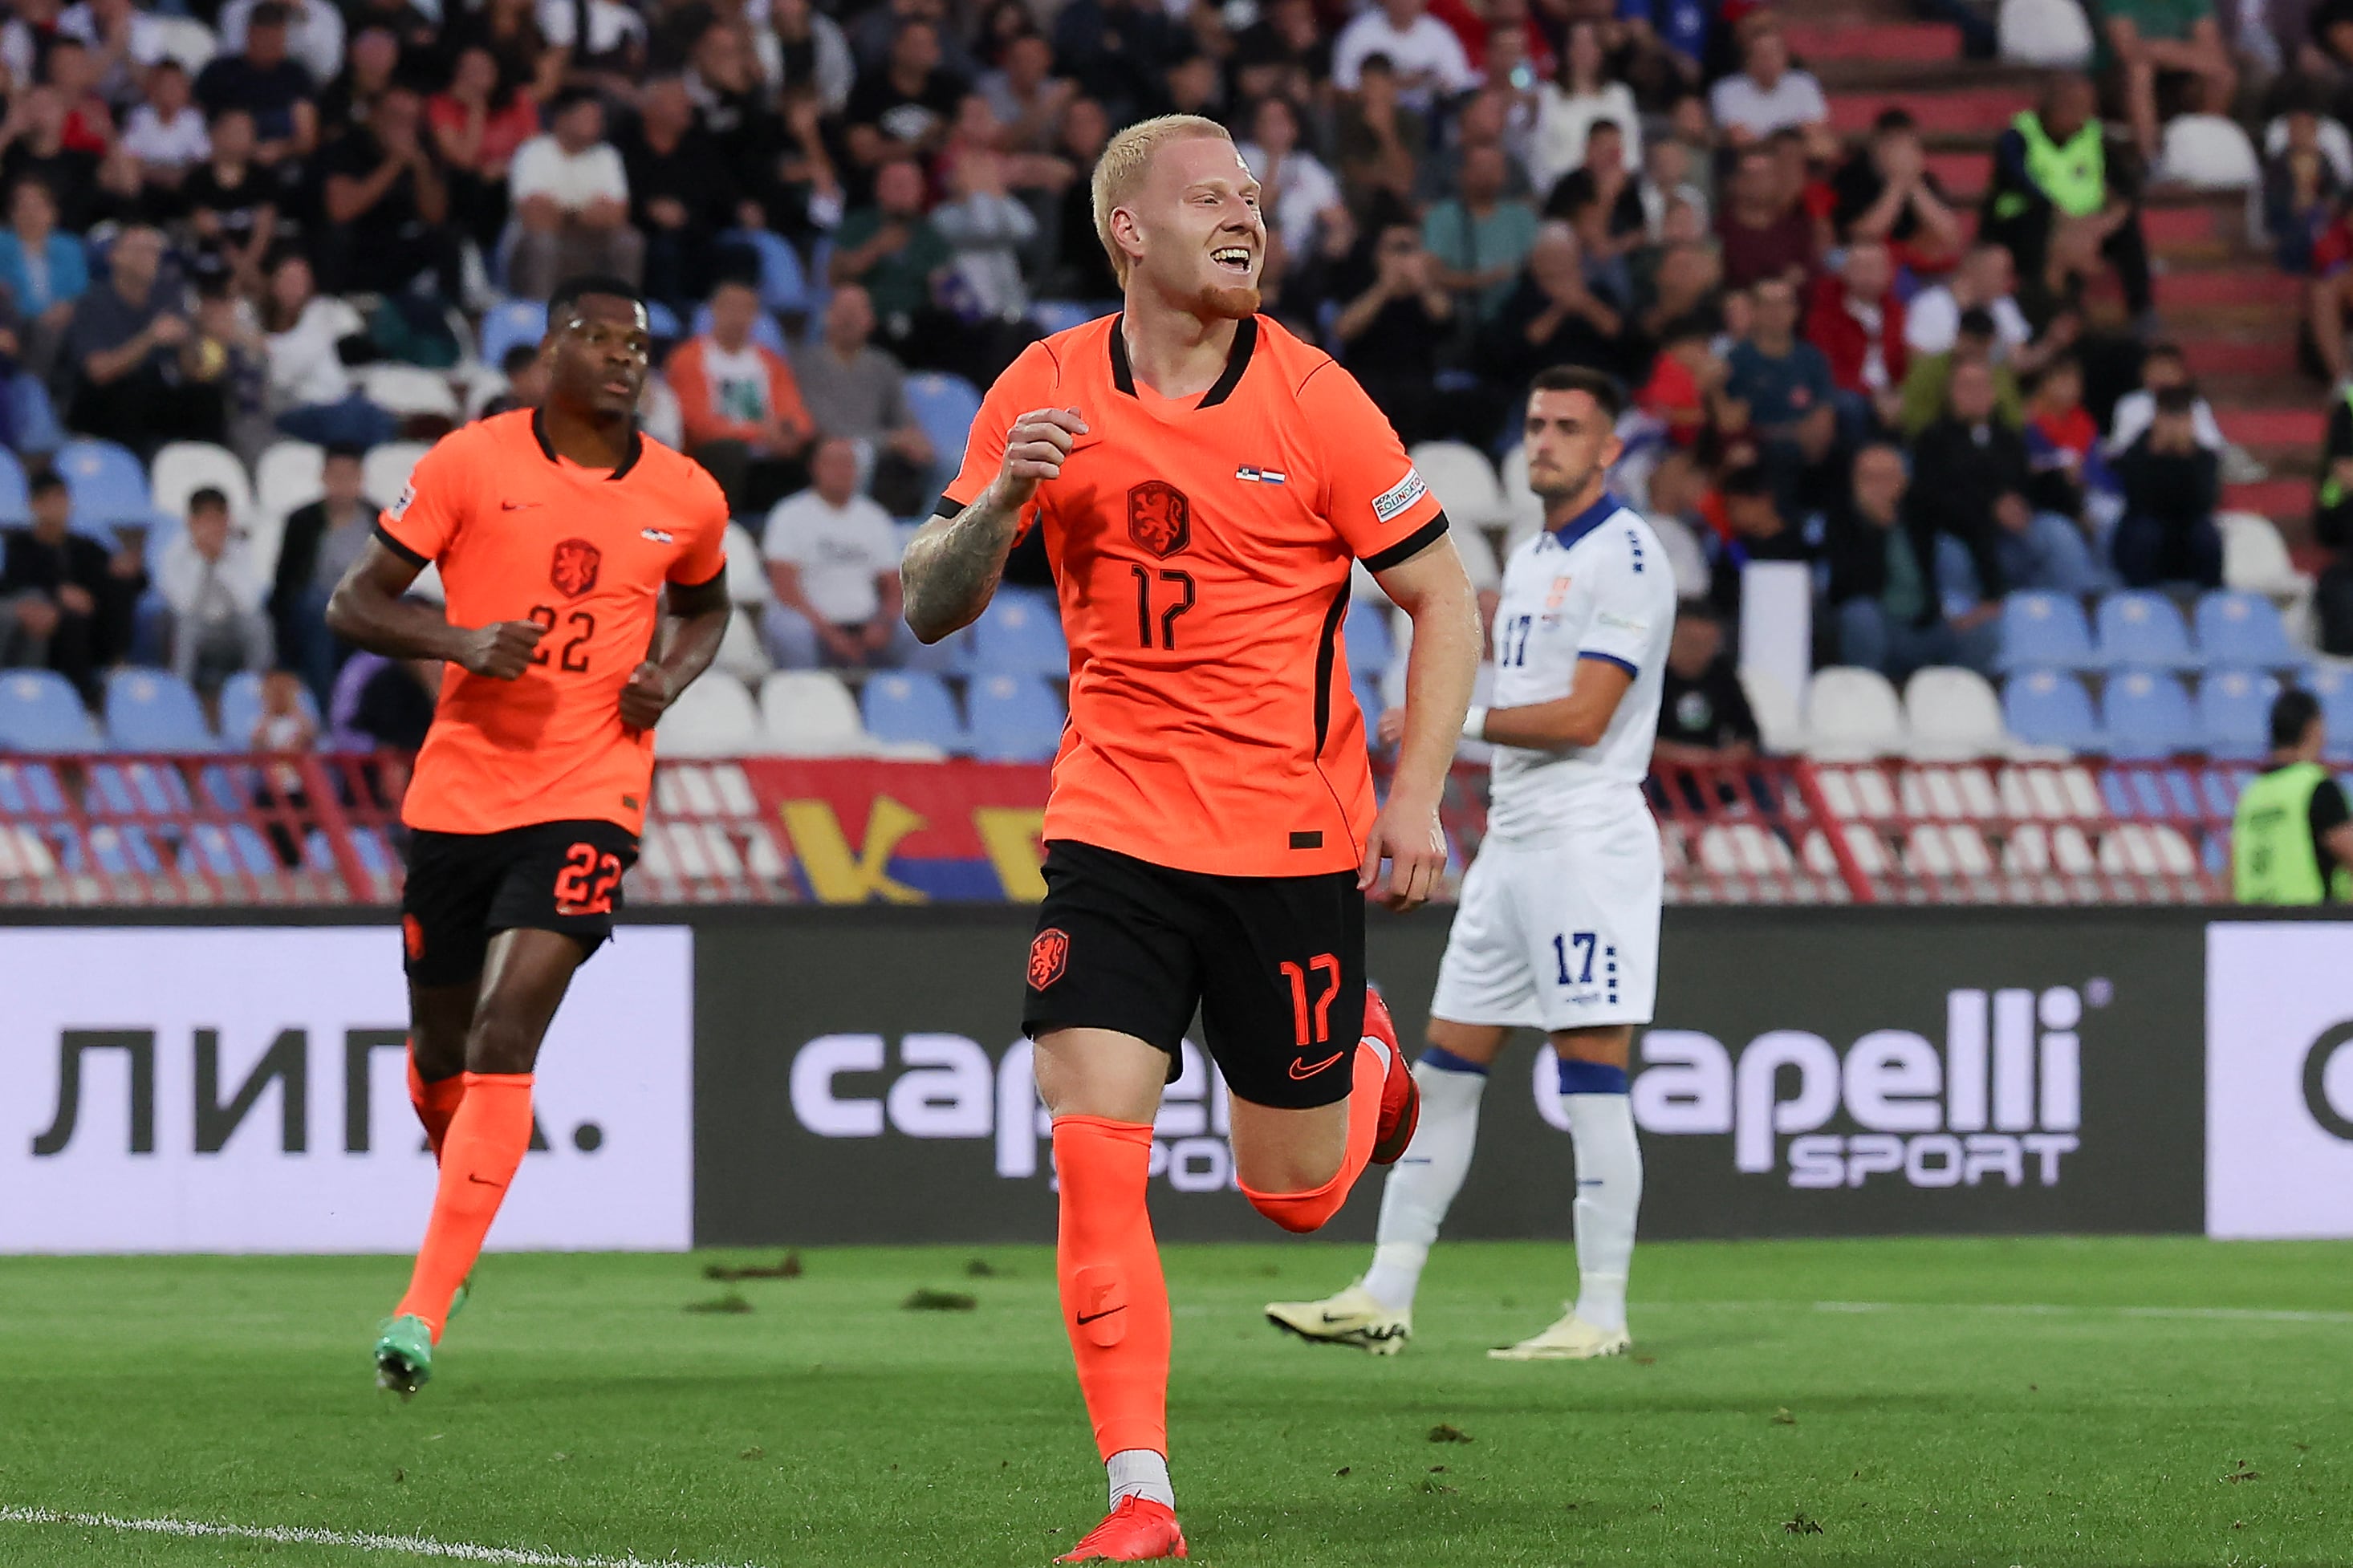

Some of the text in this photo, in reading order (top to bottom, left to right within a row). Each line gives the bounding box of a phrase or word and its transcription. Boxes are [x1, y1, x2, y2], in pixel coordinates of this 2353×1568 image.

[528, 604, 595, 672] 22
[1131, 564, 1196, 650] 17
[1502, 615, 1531, 668] 17
[554, 842, 623, 916] 22
[1554, 932, 1596, 985] 17
[1280, 953, 1341, 1046] 17
[31, 1027, 603, 1156] ЛИГ.
[1786, 1131, 2081, 1188] SPORT
